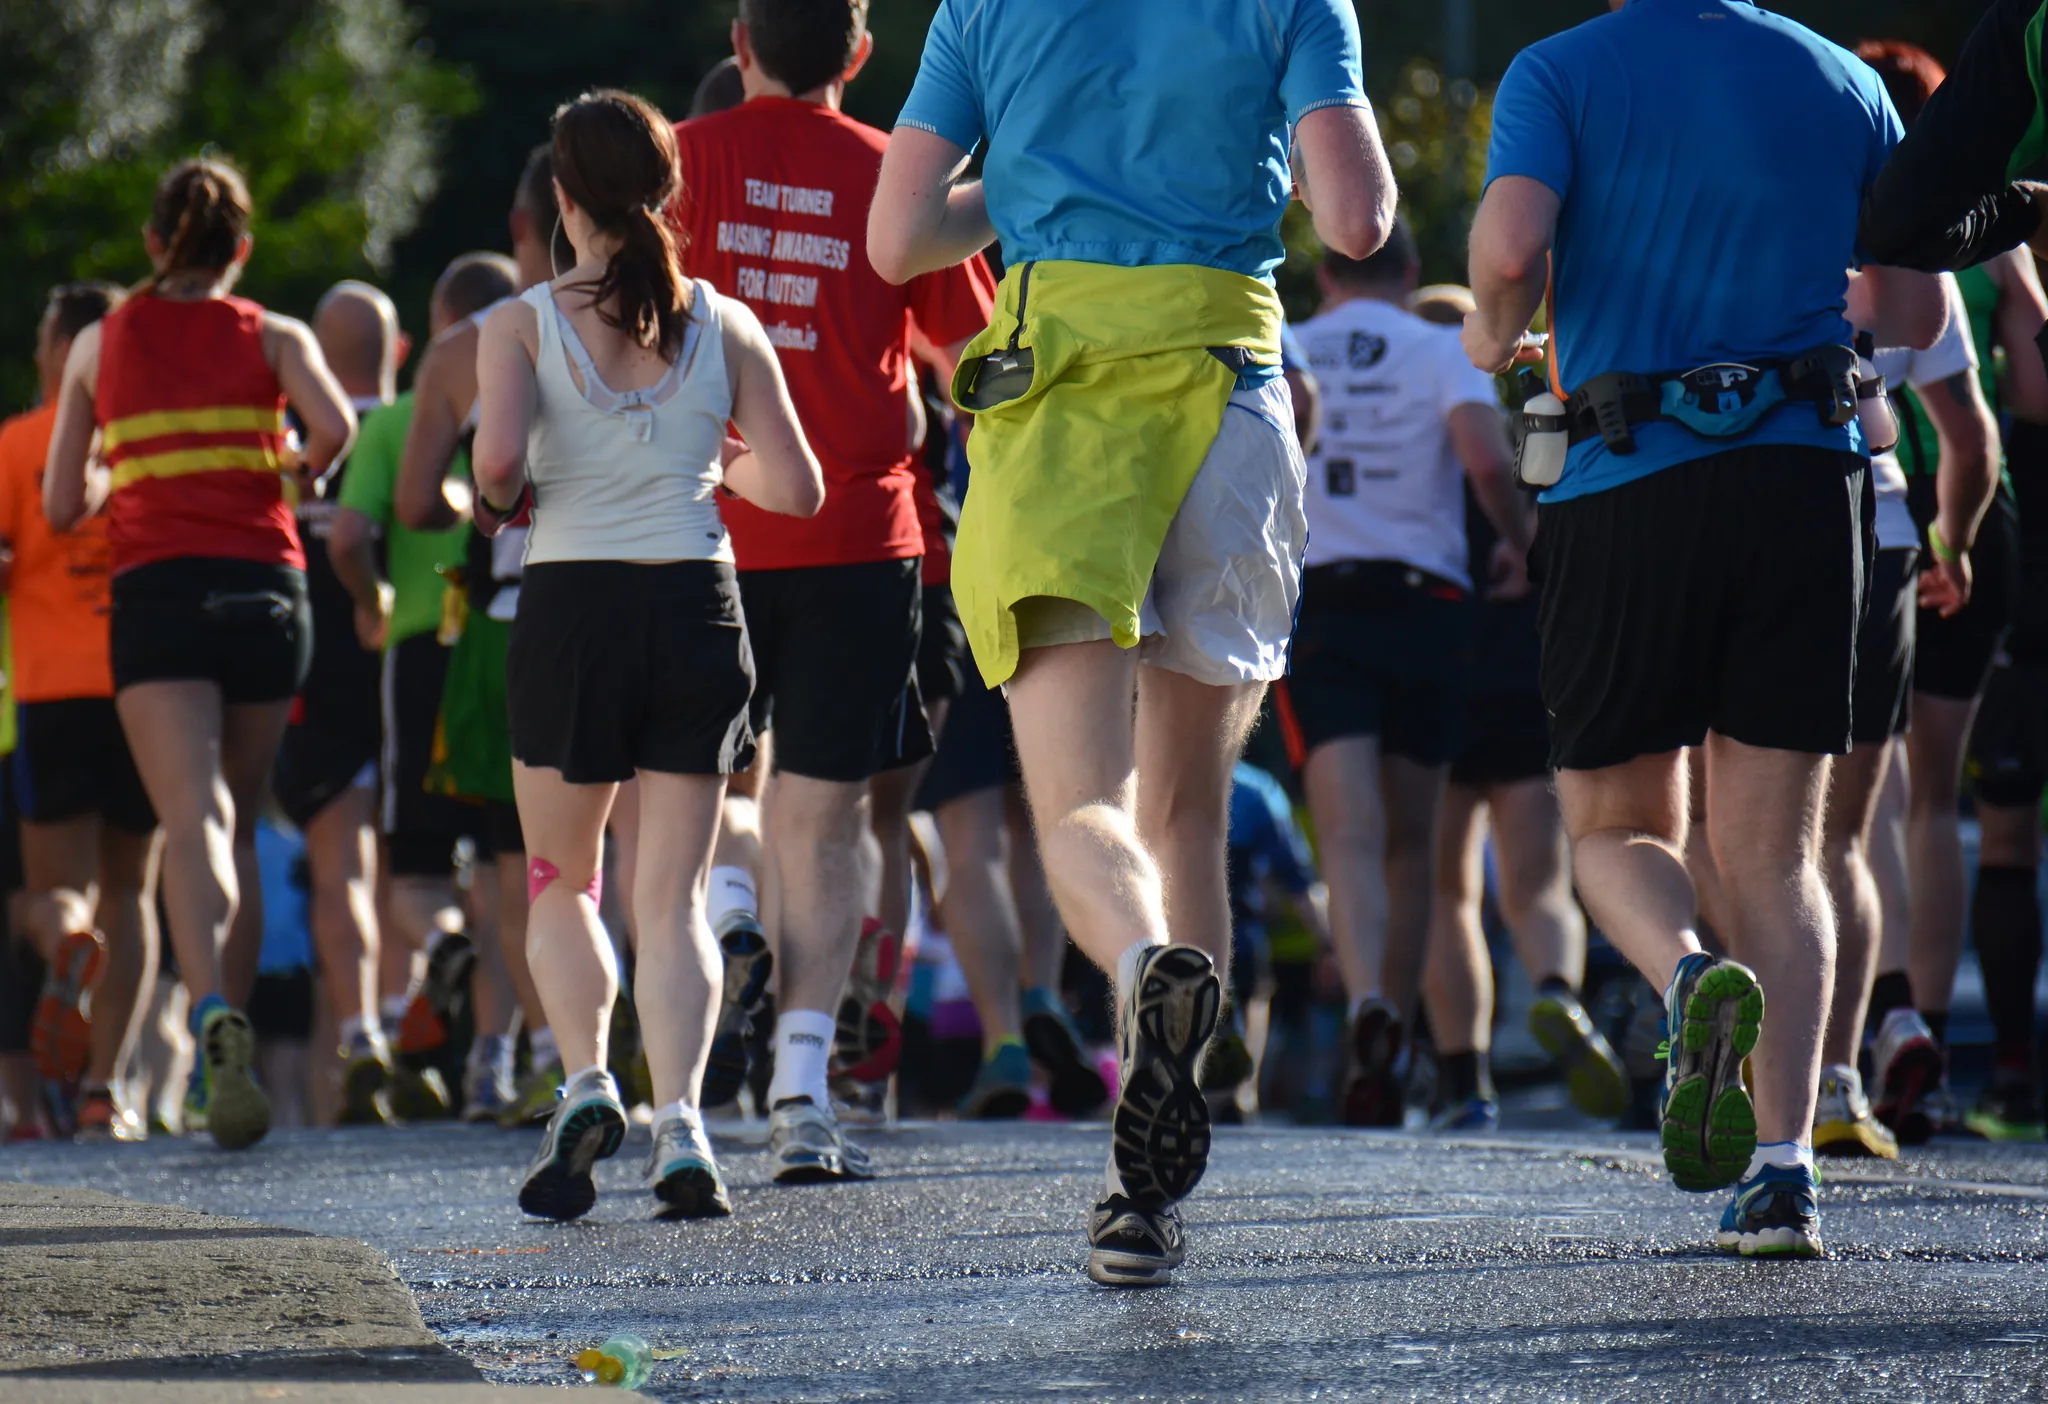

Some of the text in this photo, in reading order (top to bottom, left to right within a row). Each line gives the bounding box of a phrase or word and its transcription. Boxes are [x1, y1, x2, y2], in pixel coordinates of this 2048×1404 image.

[745, 178, 833, 217] TEAM TURNER
[717, 221, 850, 271] RAISING AWARNESS
[738, 266, 818, 307] FOR AUTISM
